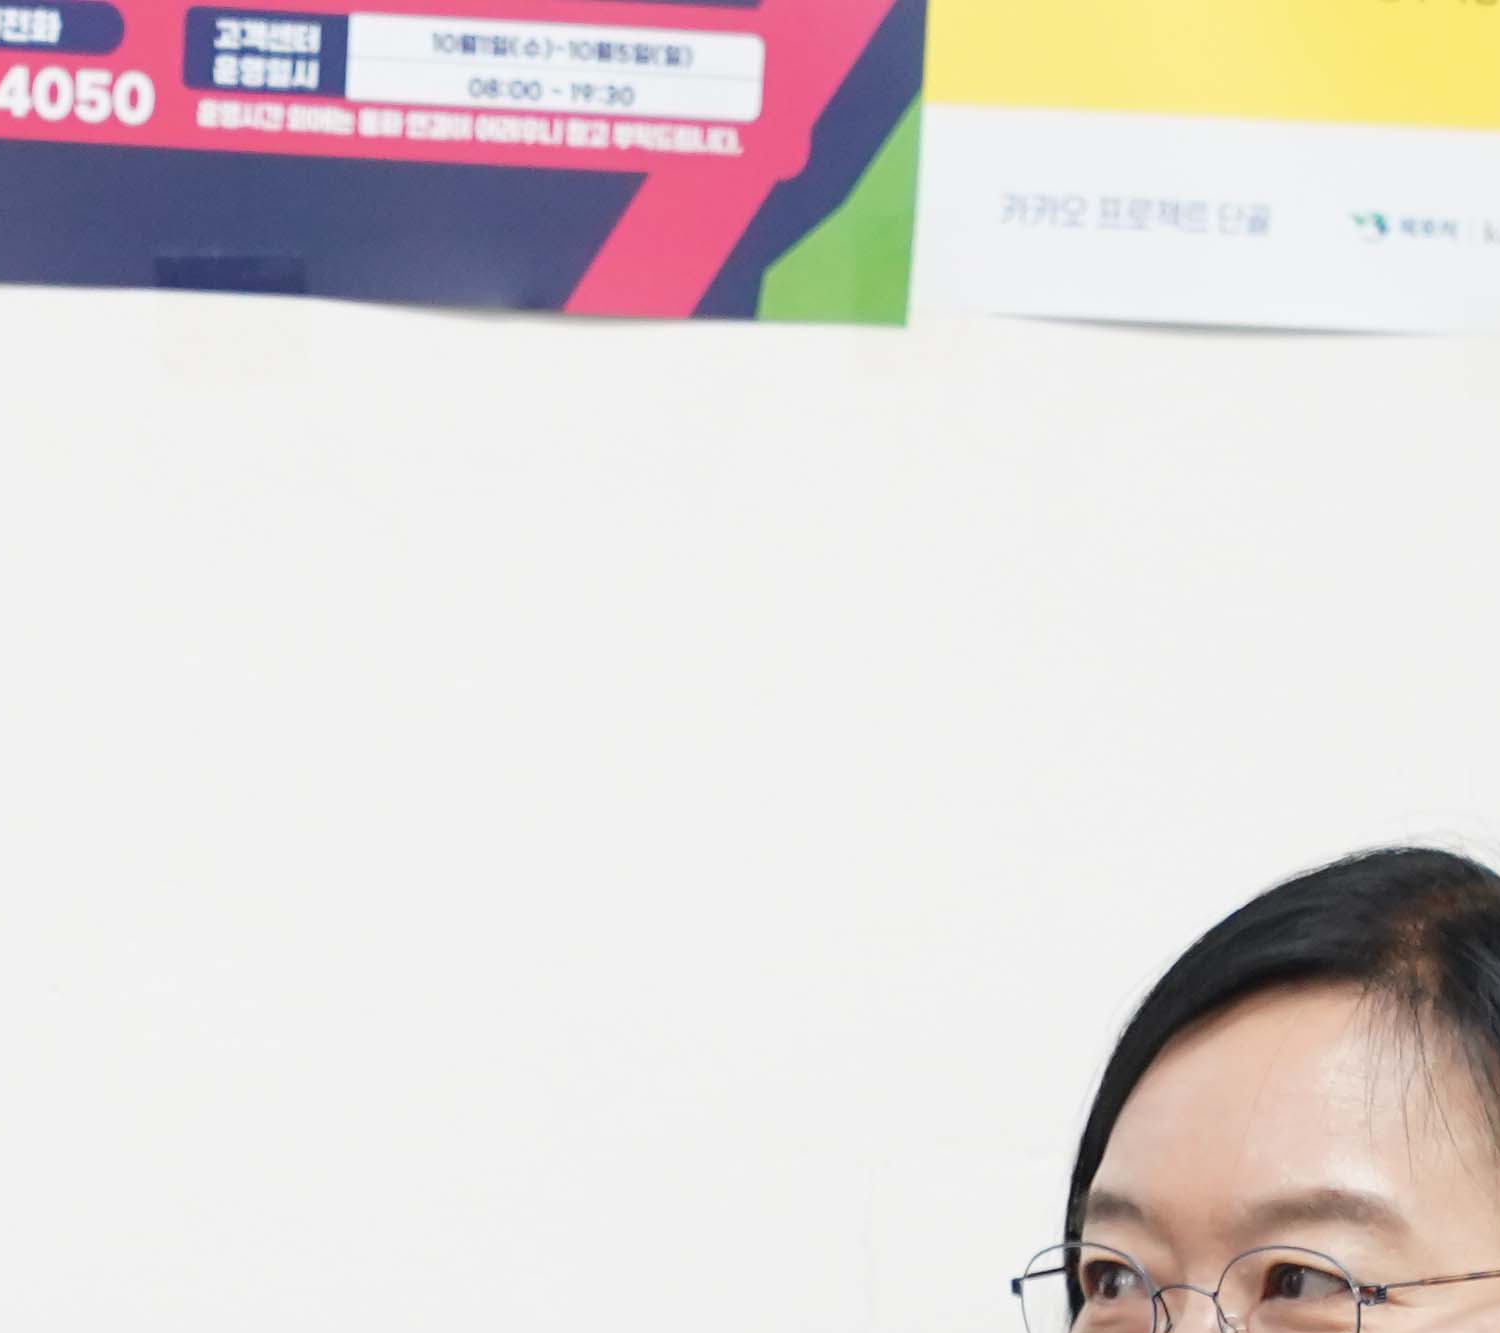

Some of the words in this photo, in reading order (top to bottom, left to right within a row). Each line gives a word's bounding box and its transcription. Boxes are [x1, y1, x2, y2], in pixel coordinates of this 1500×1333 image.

[214, 19, 321, 53] 고객센터
[467, 77, 544, 102] 08:00
[569, 82, 637, 107] 19:30
[1000, 193, 1088, 229] 카카오
[1097, 196, 1209, 234] 프로젝트
[1218, 201, 1271, 237] 단골
